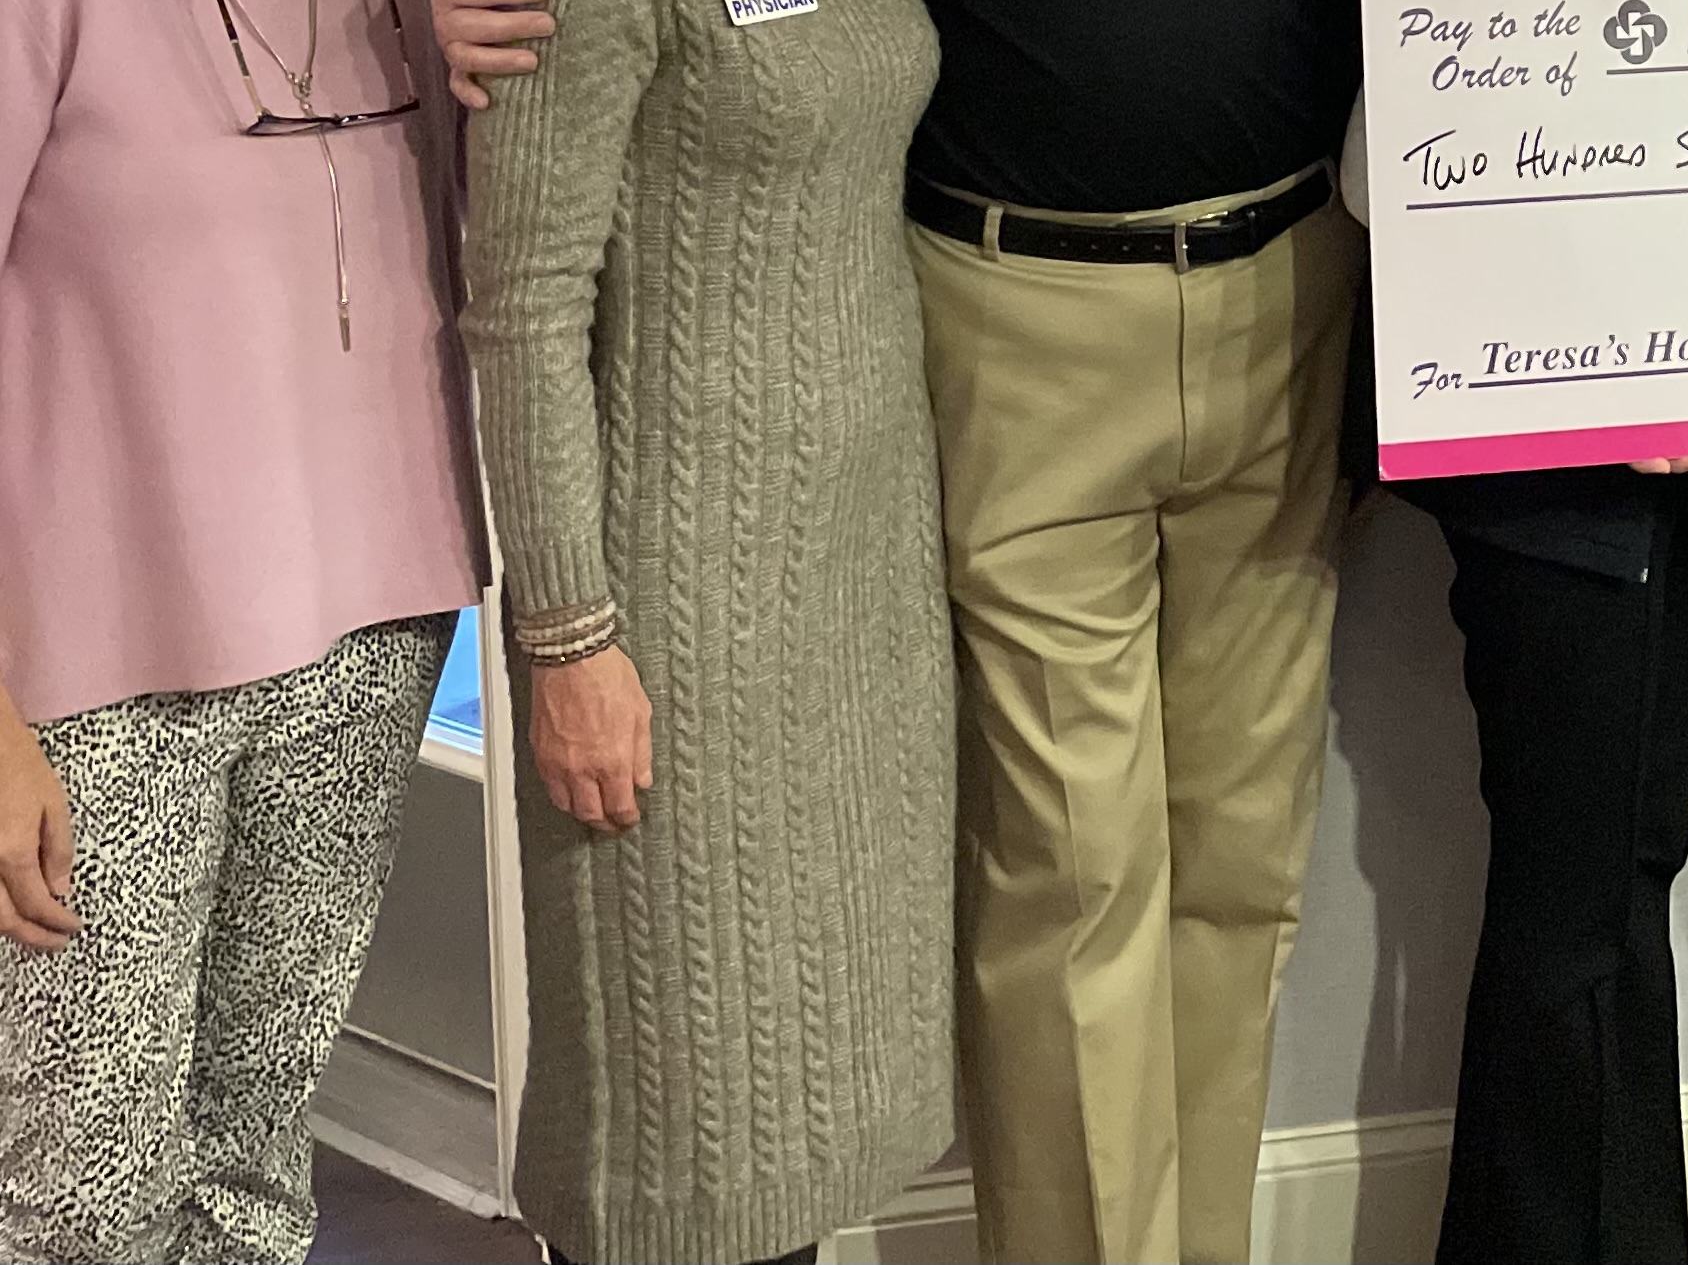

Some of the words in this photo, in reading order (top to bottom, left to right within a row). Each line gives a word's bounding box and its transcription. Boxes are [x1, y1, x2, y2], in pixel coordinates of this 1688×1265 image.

[1399, 8, 1473, 48] Pay
[1489, 12, 1516, 40] to
[1533, 0, 1581, 37] the
[1432, 54, 1531, 91] Order
[1545, 51, 1578, 97] of
[1411, 362, 1463, 400] For
[1483, 333, 1630, 375] Teresa's
